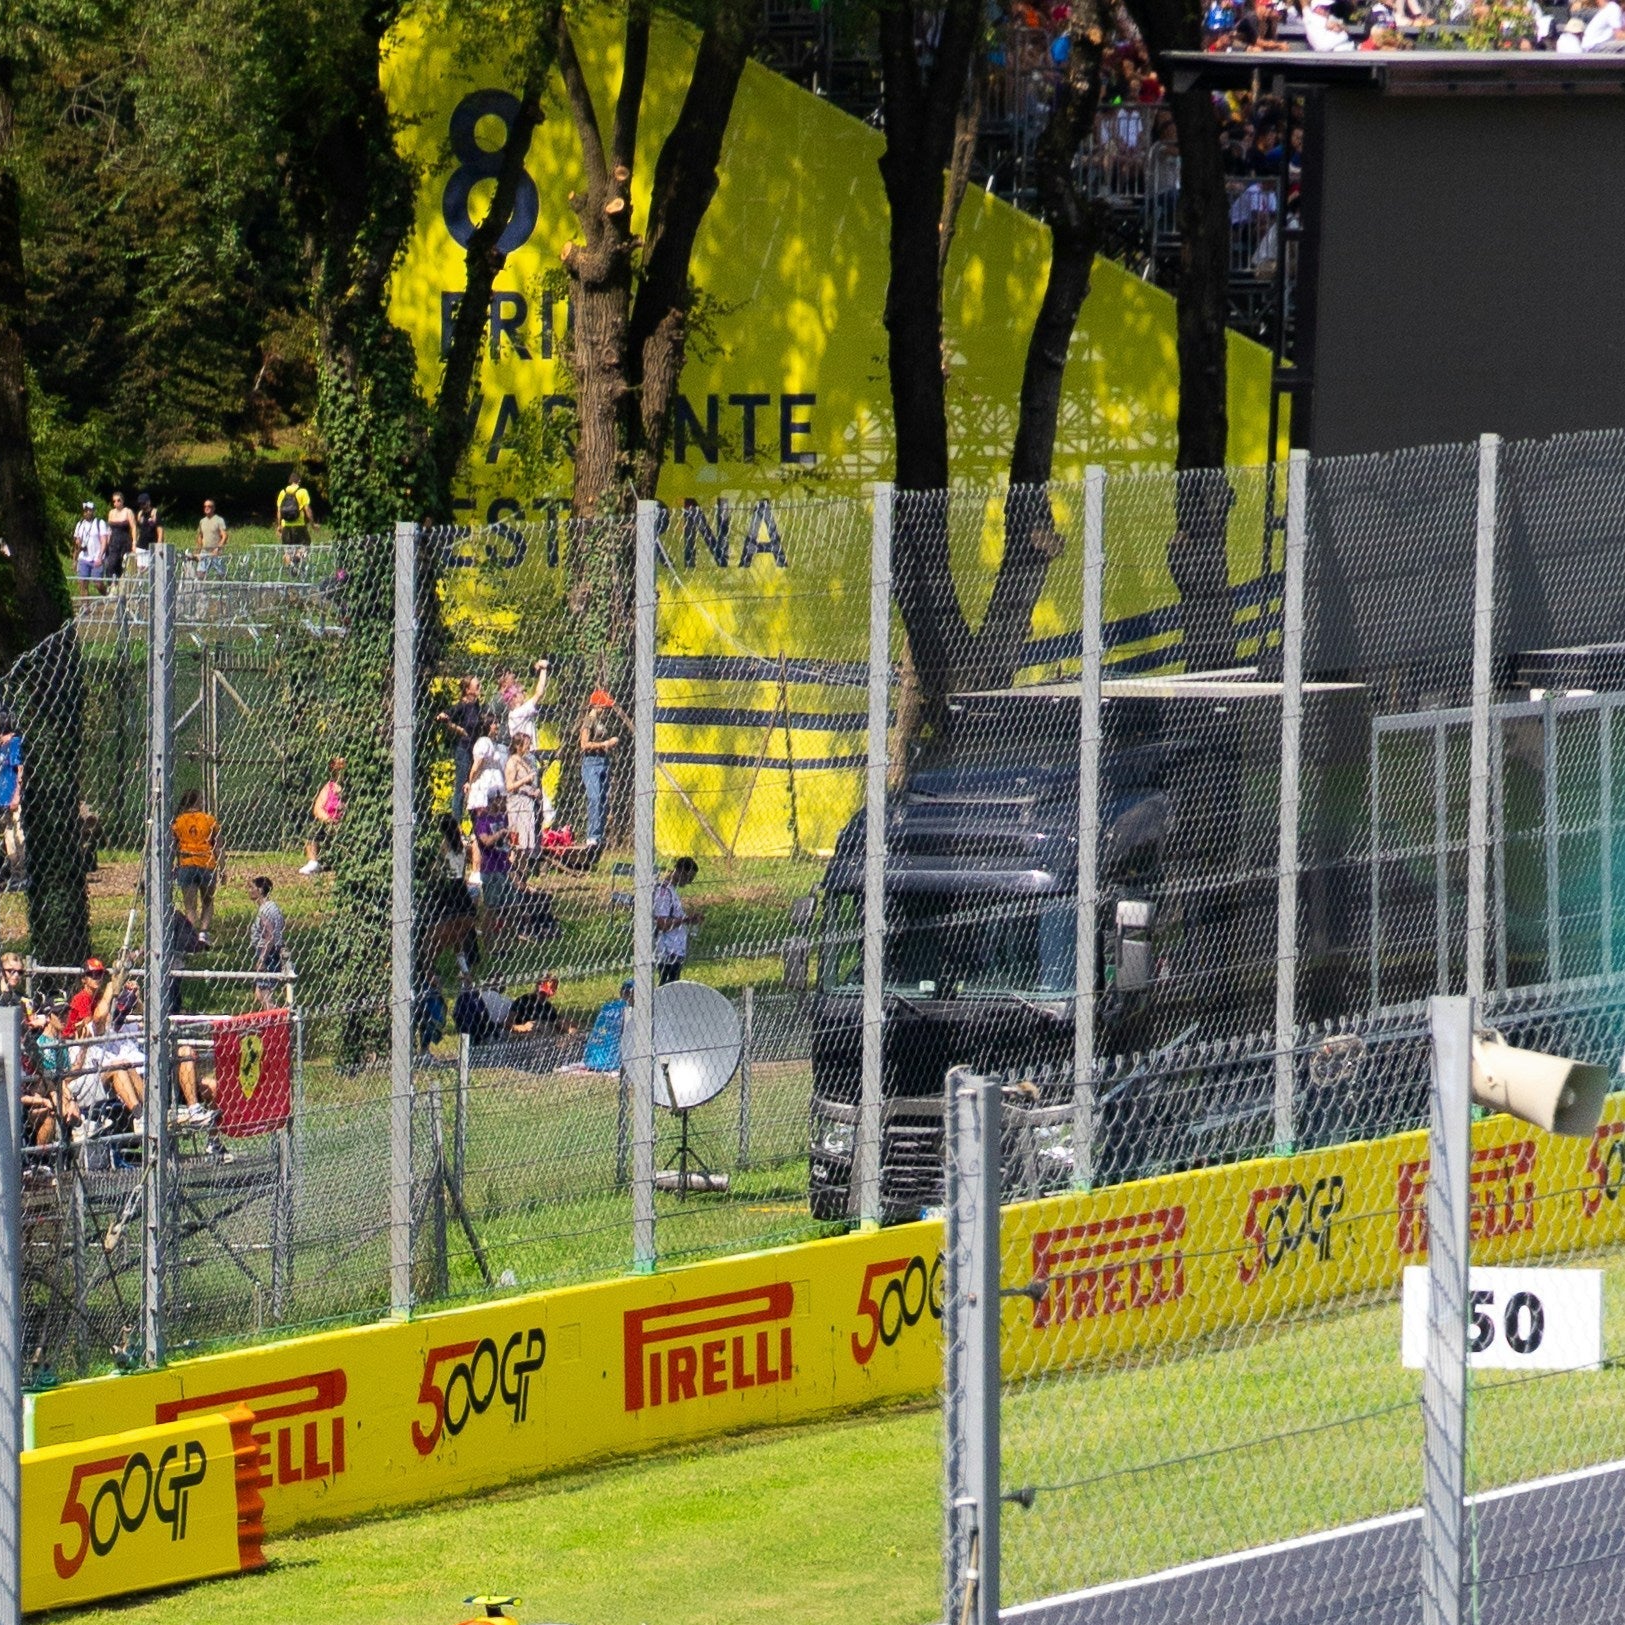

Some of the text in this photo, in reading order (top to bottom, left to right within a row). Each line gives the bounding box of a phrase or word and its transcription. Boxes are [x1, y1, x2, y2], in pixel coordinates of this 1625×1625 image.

[442, 88, 540, 254] 8
[441, 290, 576, 360] PRI
[851, 1251, 945, 1366] 500G
[1033, 1205, 1185, 1329] PIRELLI
[1468, 1290, 1545, 1354] 50
[411, 1327, 546, 1456] 500GP
[623, 1281, 794, 1412] PIRELLI
[155, 1368, 347, 1485] PELLI
[53, 1440, 208, 1580] 500GP
